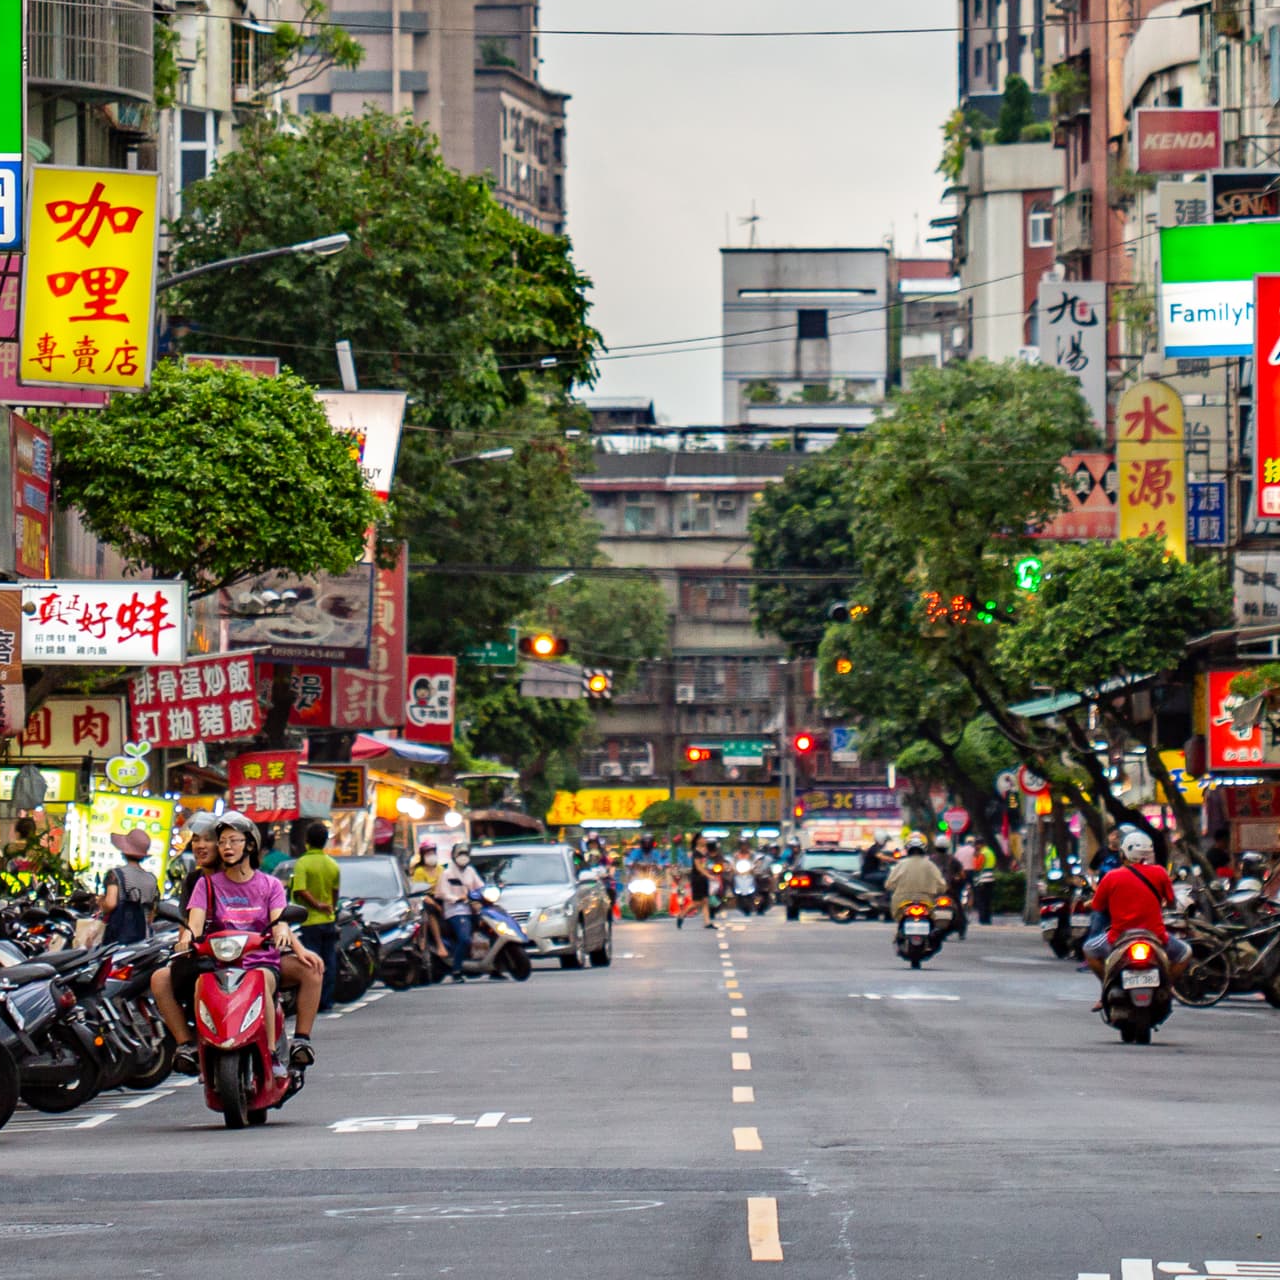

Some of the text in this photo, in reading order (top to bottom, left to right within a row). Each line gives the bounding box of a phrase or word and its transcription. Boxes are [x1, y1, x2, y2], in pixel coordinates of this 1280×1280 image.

[1143, 131, 1216, 151] KENDA
[46, 182, 142, 323] 咖哩
[28, 332, 139, 377] 專賣店
[133, 661, 252, 705] 排骨蛋炒飯
[135, 699, 257, 744] 打拋豬飯
